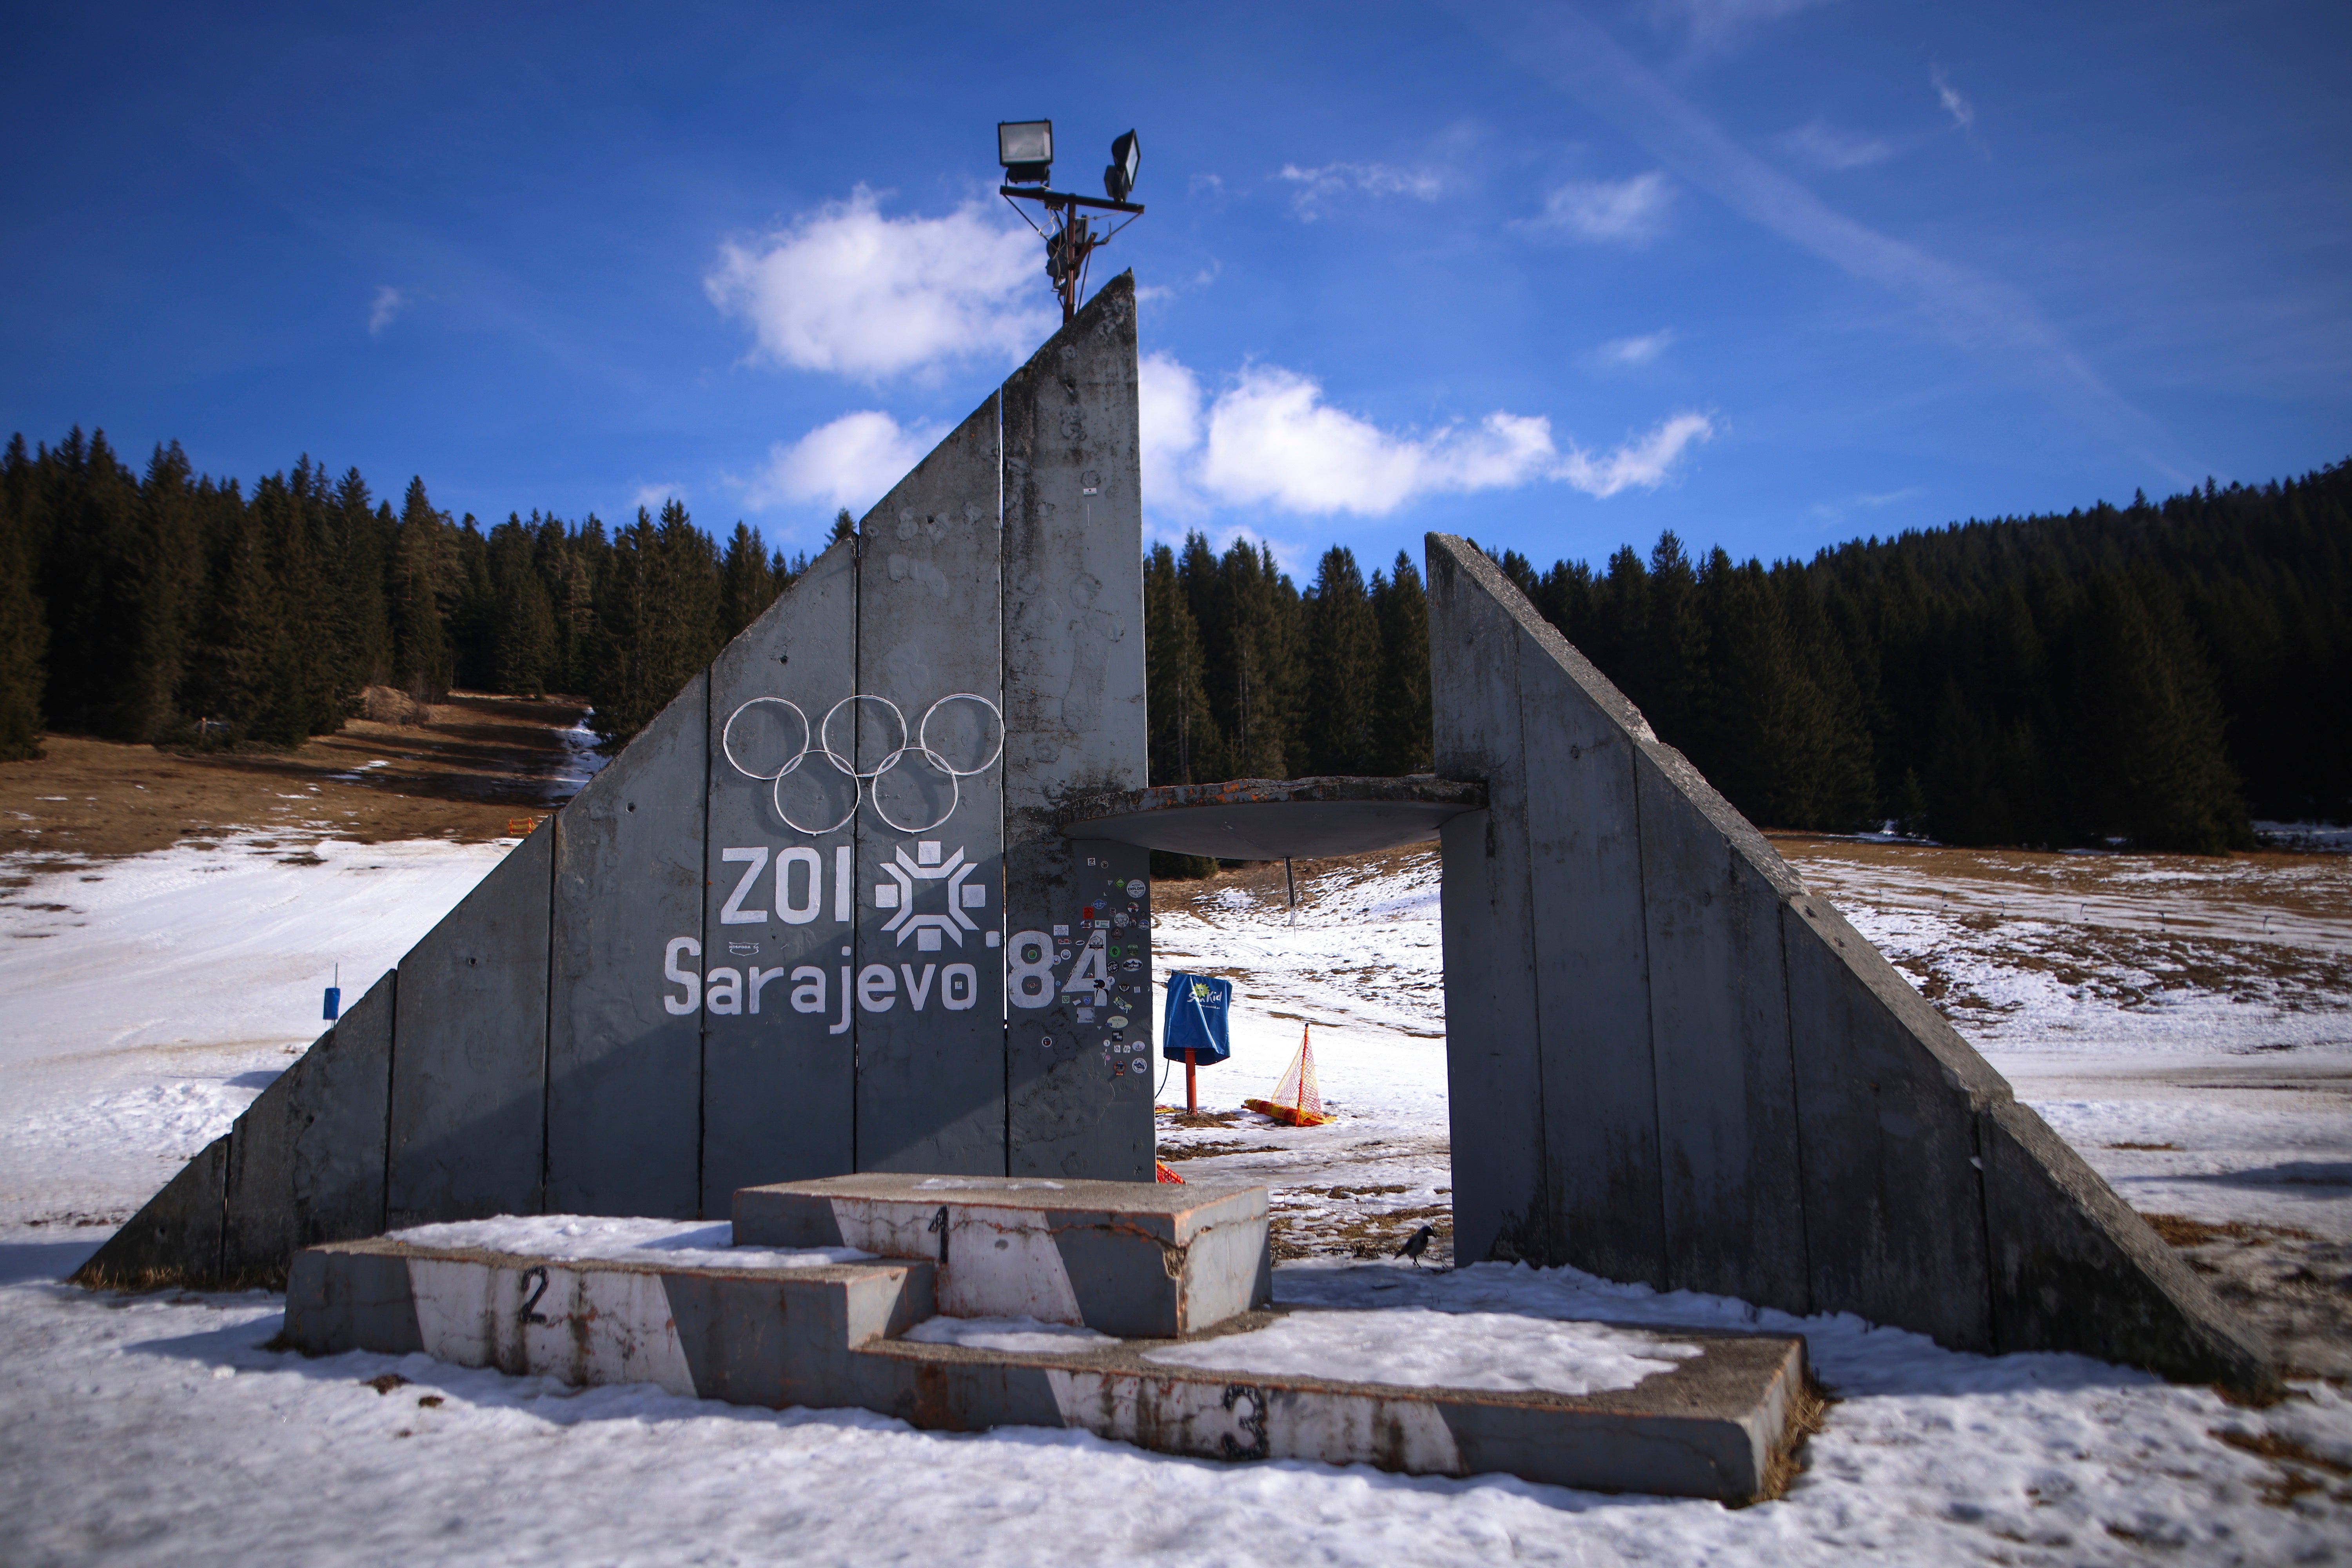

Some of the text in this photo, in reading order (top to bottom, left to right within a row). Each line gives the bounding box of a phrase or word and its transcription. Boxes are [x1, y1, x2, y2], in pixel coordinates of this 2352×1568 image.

[720, 846, 851, 925] ZOI
[664, 936, 977, 1034] Sarajevo
[928, 1204, 950, 1264] 1
[520, 1265, 550, 1323] 2
[1222, 1384, 1266, 1461] 3
